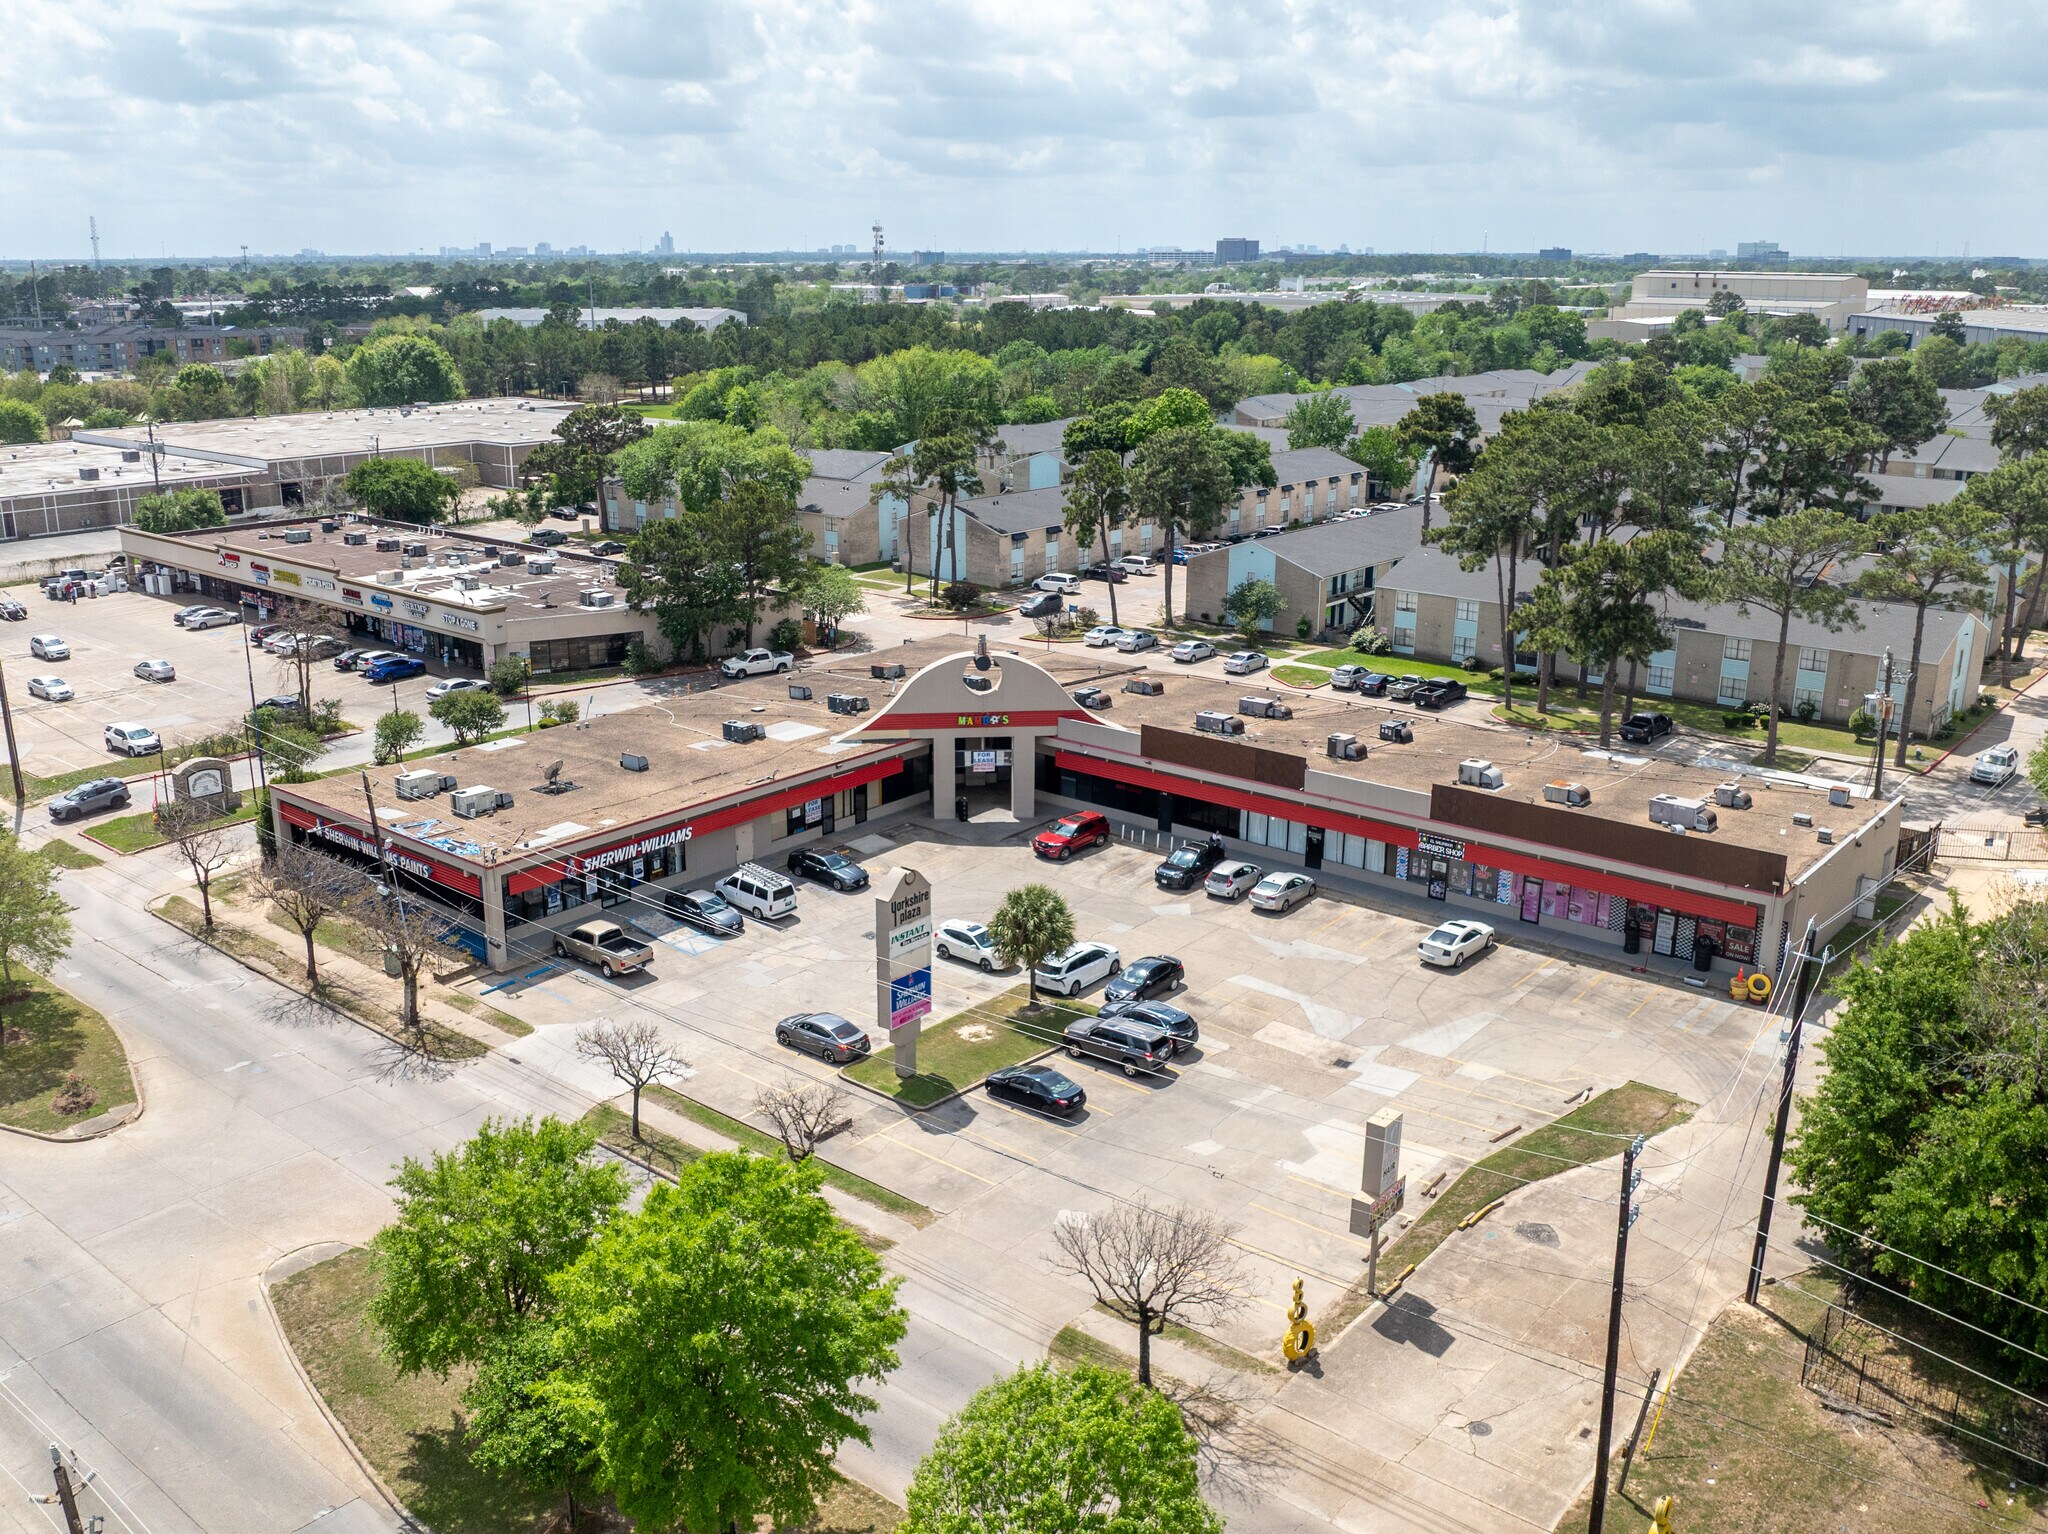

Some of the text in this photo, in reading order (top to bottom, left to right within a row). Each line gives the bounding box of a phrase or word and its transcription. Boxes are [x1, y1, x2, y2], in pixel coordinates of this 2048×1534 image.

[401, 600, 428, 614] SHRIMP
[441, 613, 456, 625] STOP
[460, 618, 477, 631] GONE
[806, 804, 821, 813] LEASE
[583, 826, 693, 873] SHERWIN-WILLIAMS
[1420, 842, 1463, 858] BARBER SHOP
[400, 856, 429, 879] PAINTS
[891, 891, 929, 927] Yorkshire
[900, 906, 921, 925] plaza
[891, 924, 926, 944] INSTANT
[1728, 942, 1750, 953] SALE
